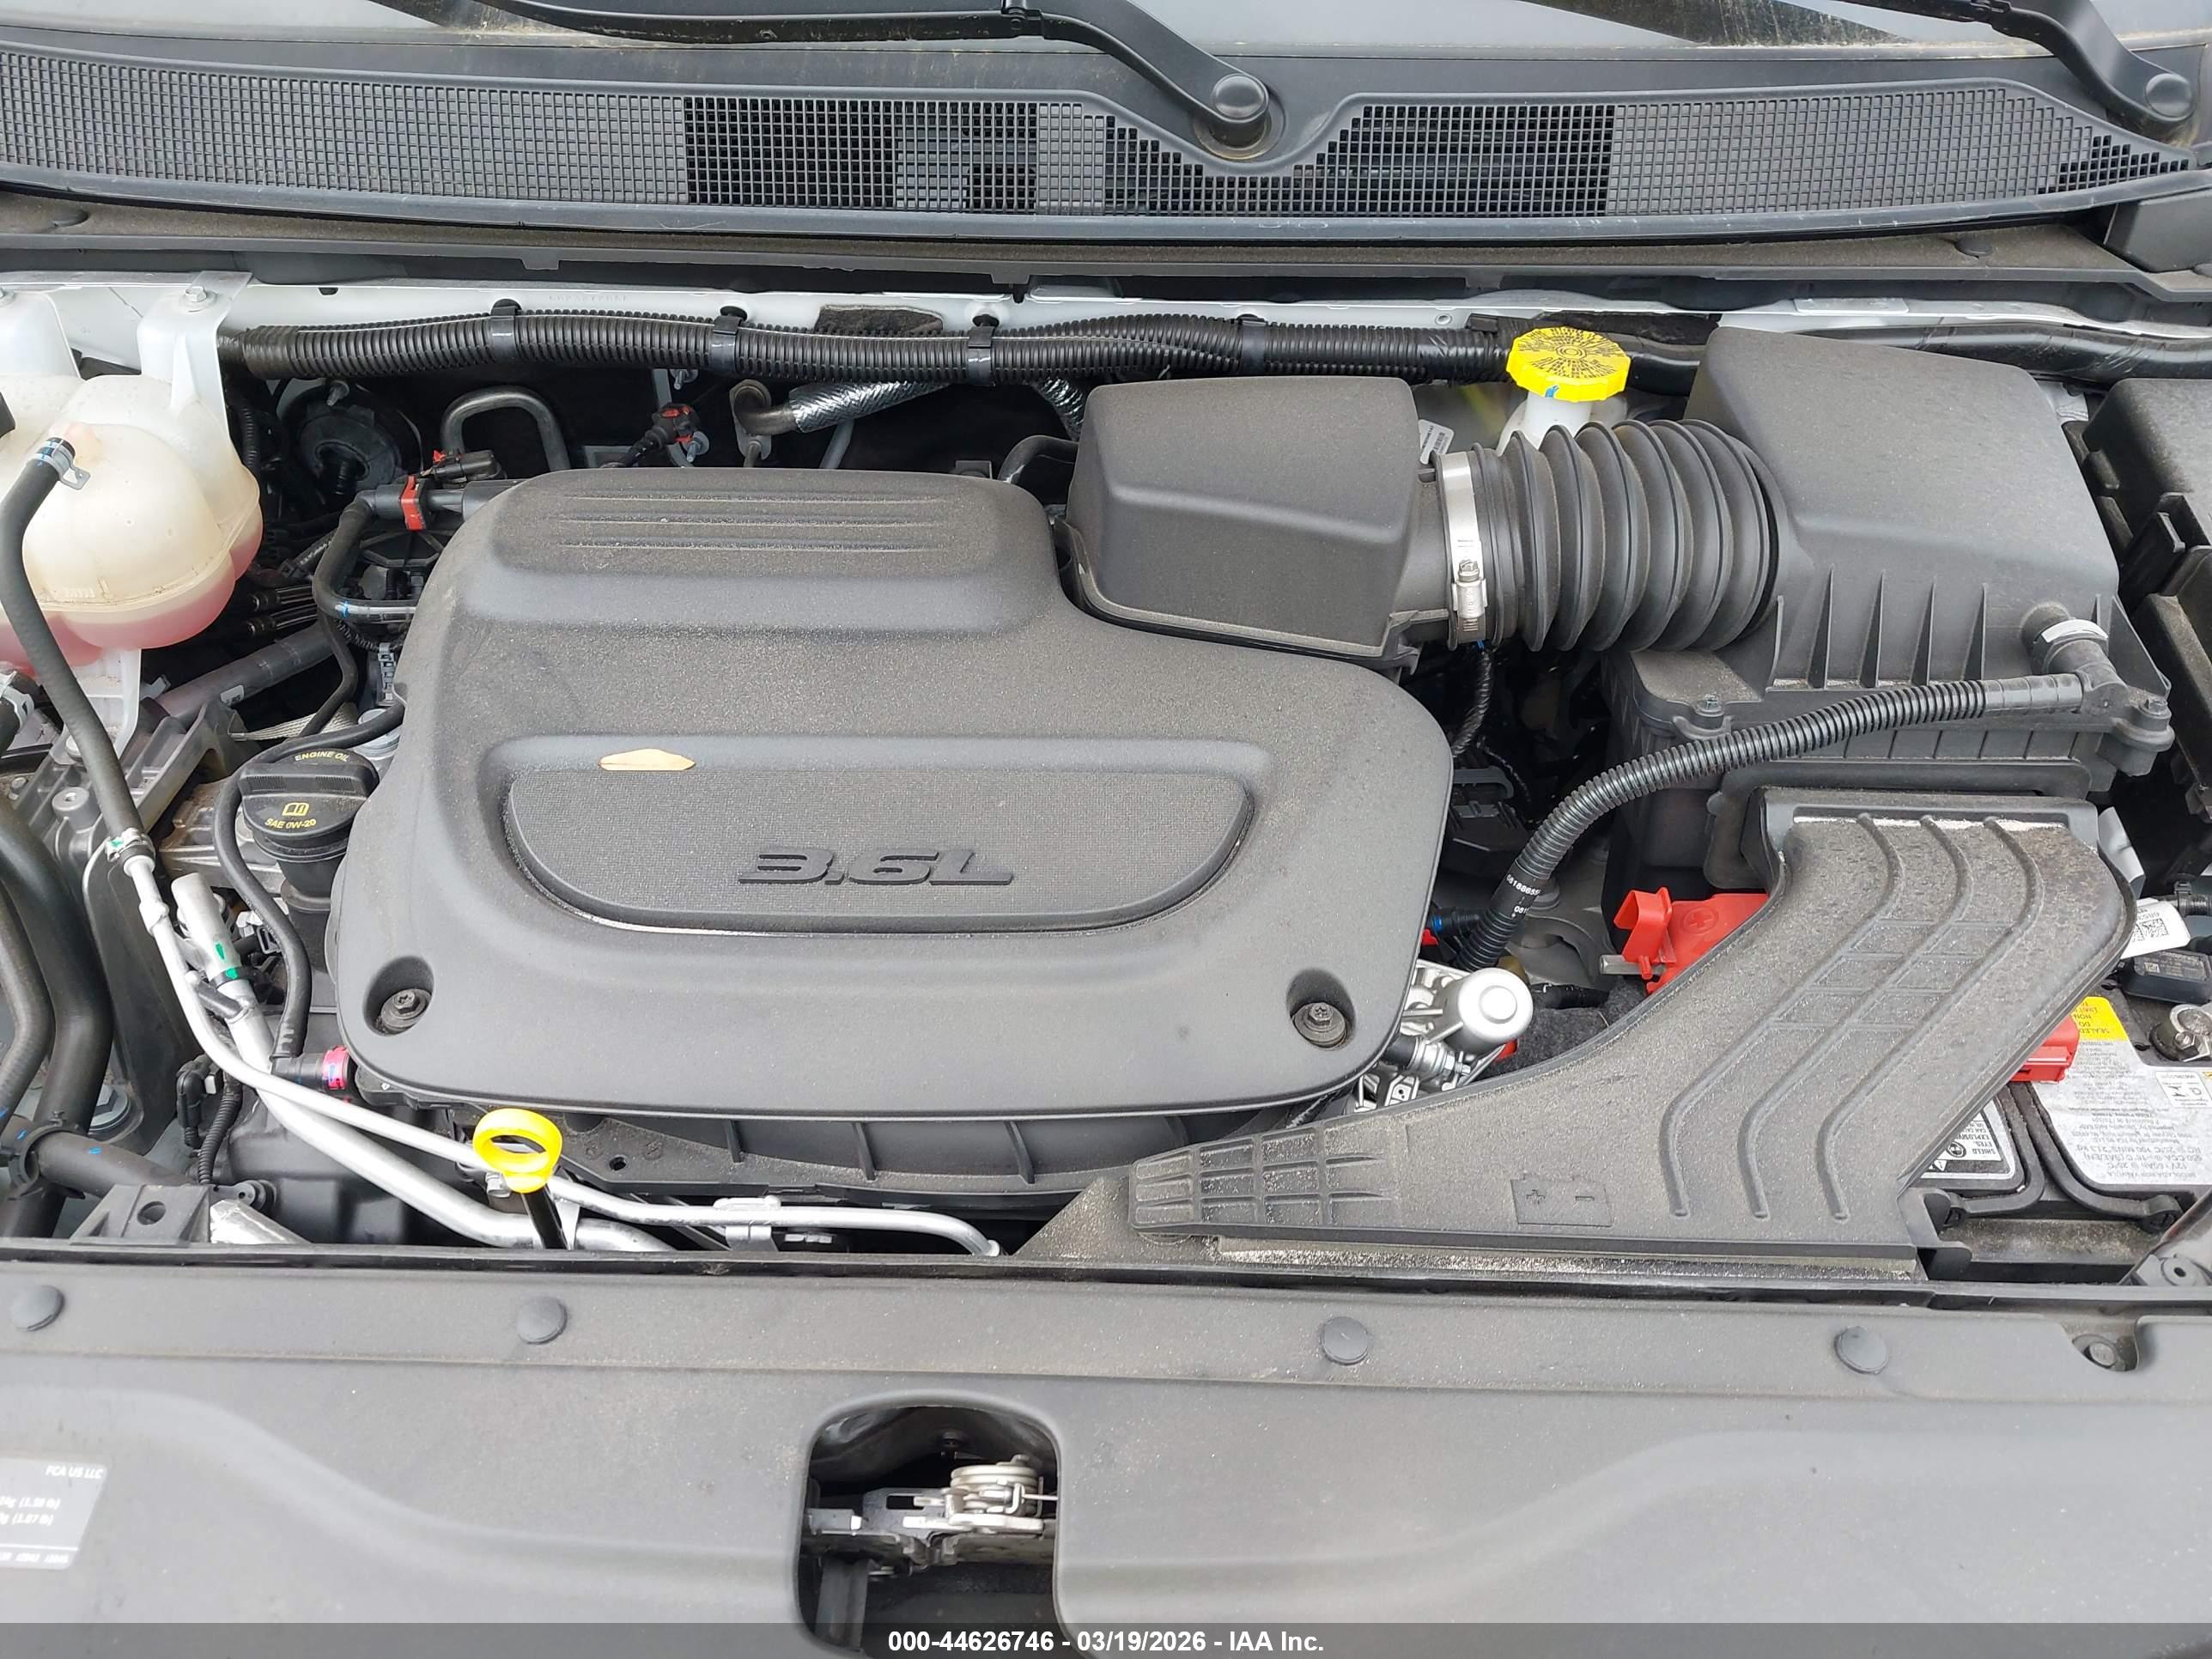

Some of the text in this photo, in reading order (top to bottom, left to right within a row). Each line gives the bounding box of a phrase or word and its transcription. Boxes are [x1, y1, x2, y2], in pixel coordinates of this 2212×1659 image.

[295, 750, 350, 763] ENGINE OIL
[264, 818, 317, 830] SAE 0W-20
[738, 847, 1014, 885] 3.6L
[46, 1464, 67, 1477] FCA
[84, 1467, 104, 1480] LLC
